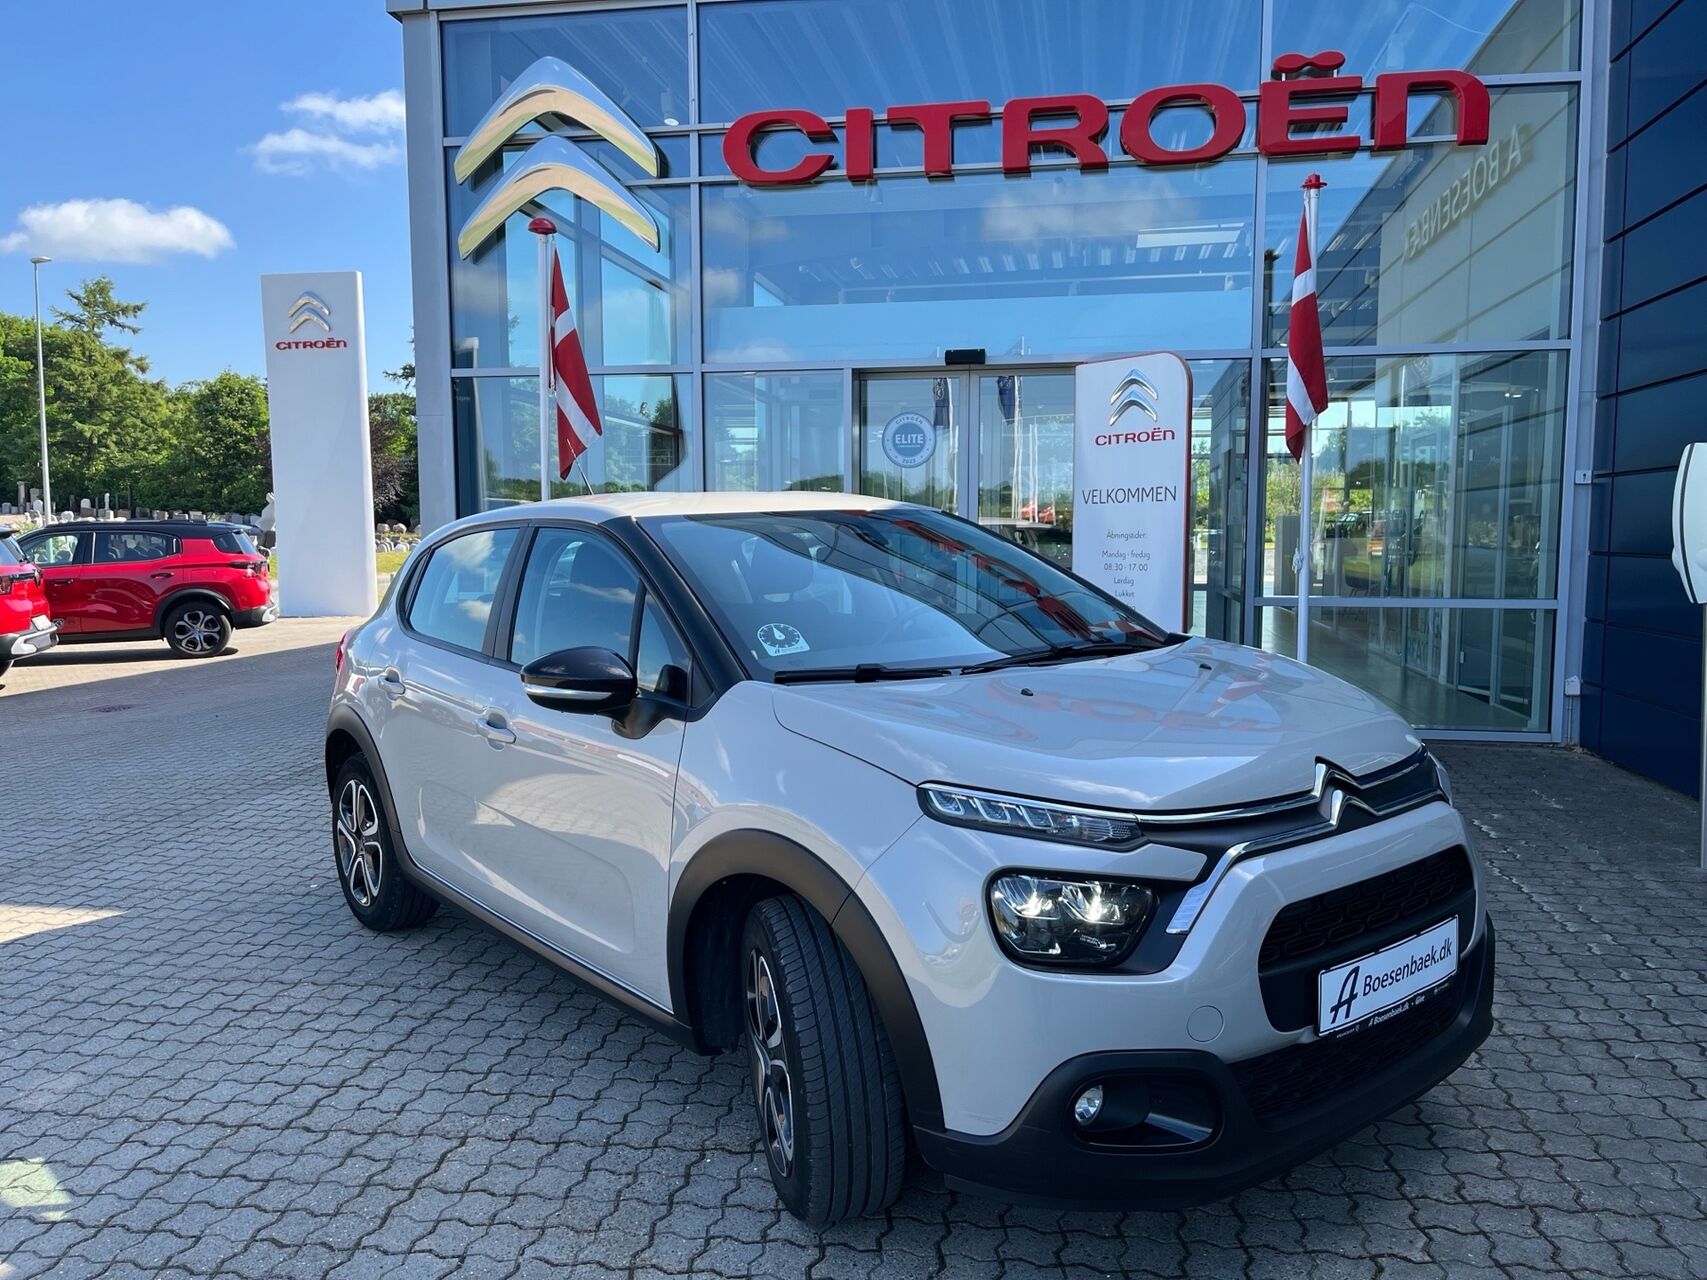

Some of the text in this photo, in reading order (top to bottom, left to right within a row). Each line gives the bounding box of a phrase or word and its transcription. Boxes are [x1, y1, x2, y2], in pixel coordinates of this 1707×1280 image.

[722, 50, 1491, 186] CITROËN
[275, 337, 348, 351] CITROËN
[895, 433, 924, 444] ELITE
[1095, 427, 1176, 446] CITROËN
[1082, 485, 1177, 505] VELKOMMEN
[1101, 550, 1127, 560] Mandag
[1130, 550, 1151, 560] fredag
[1114, 589, 1135, 598] Lukket
[1330, 937, 1453, 1025] A Boesenbaek.dk
